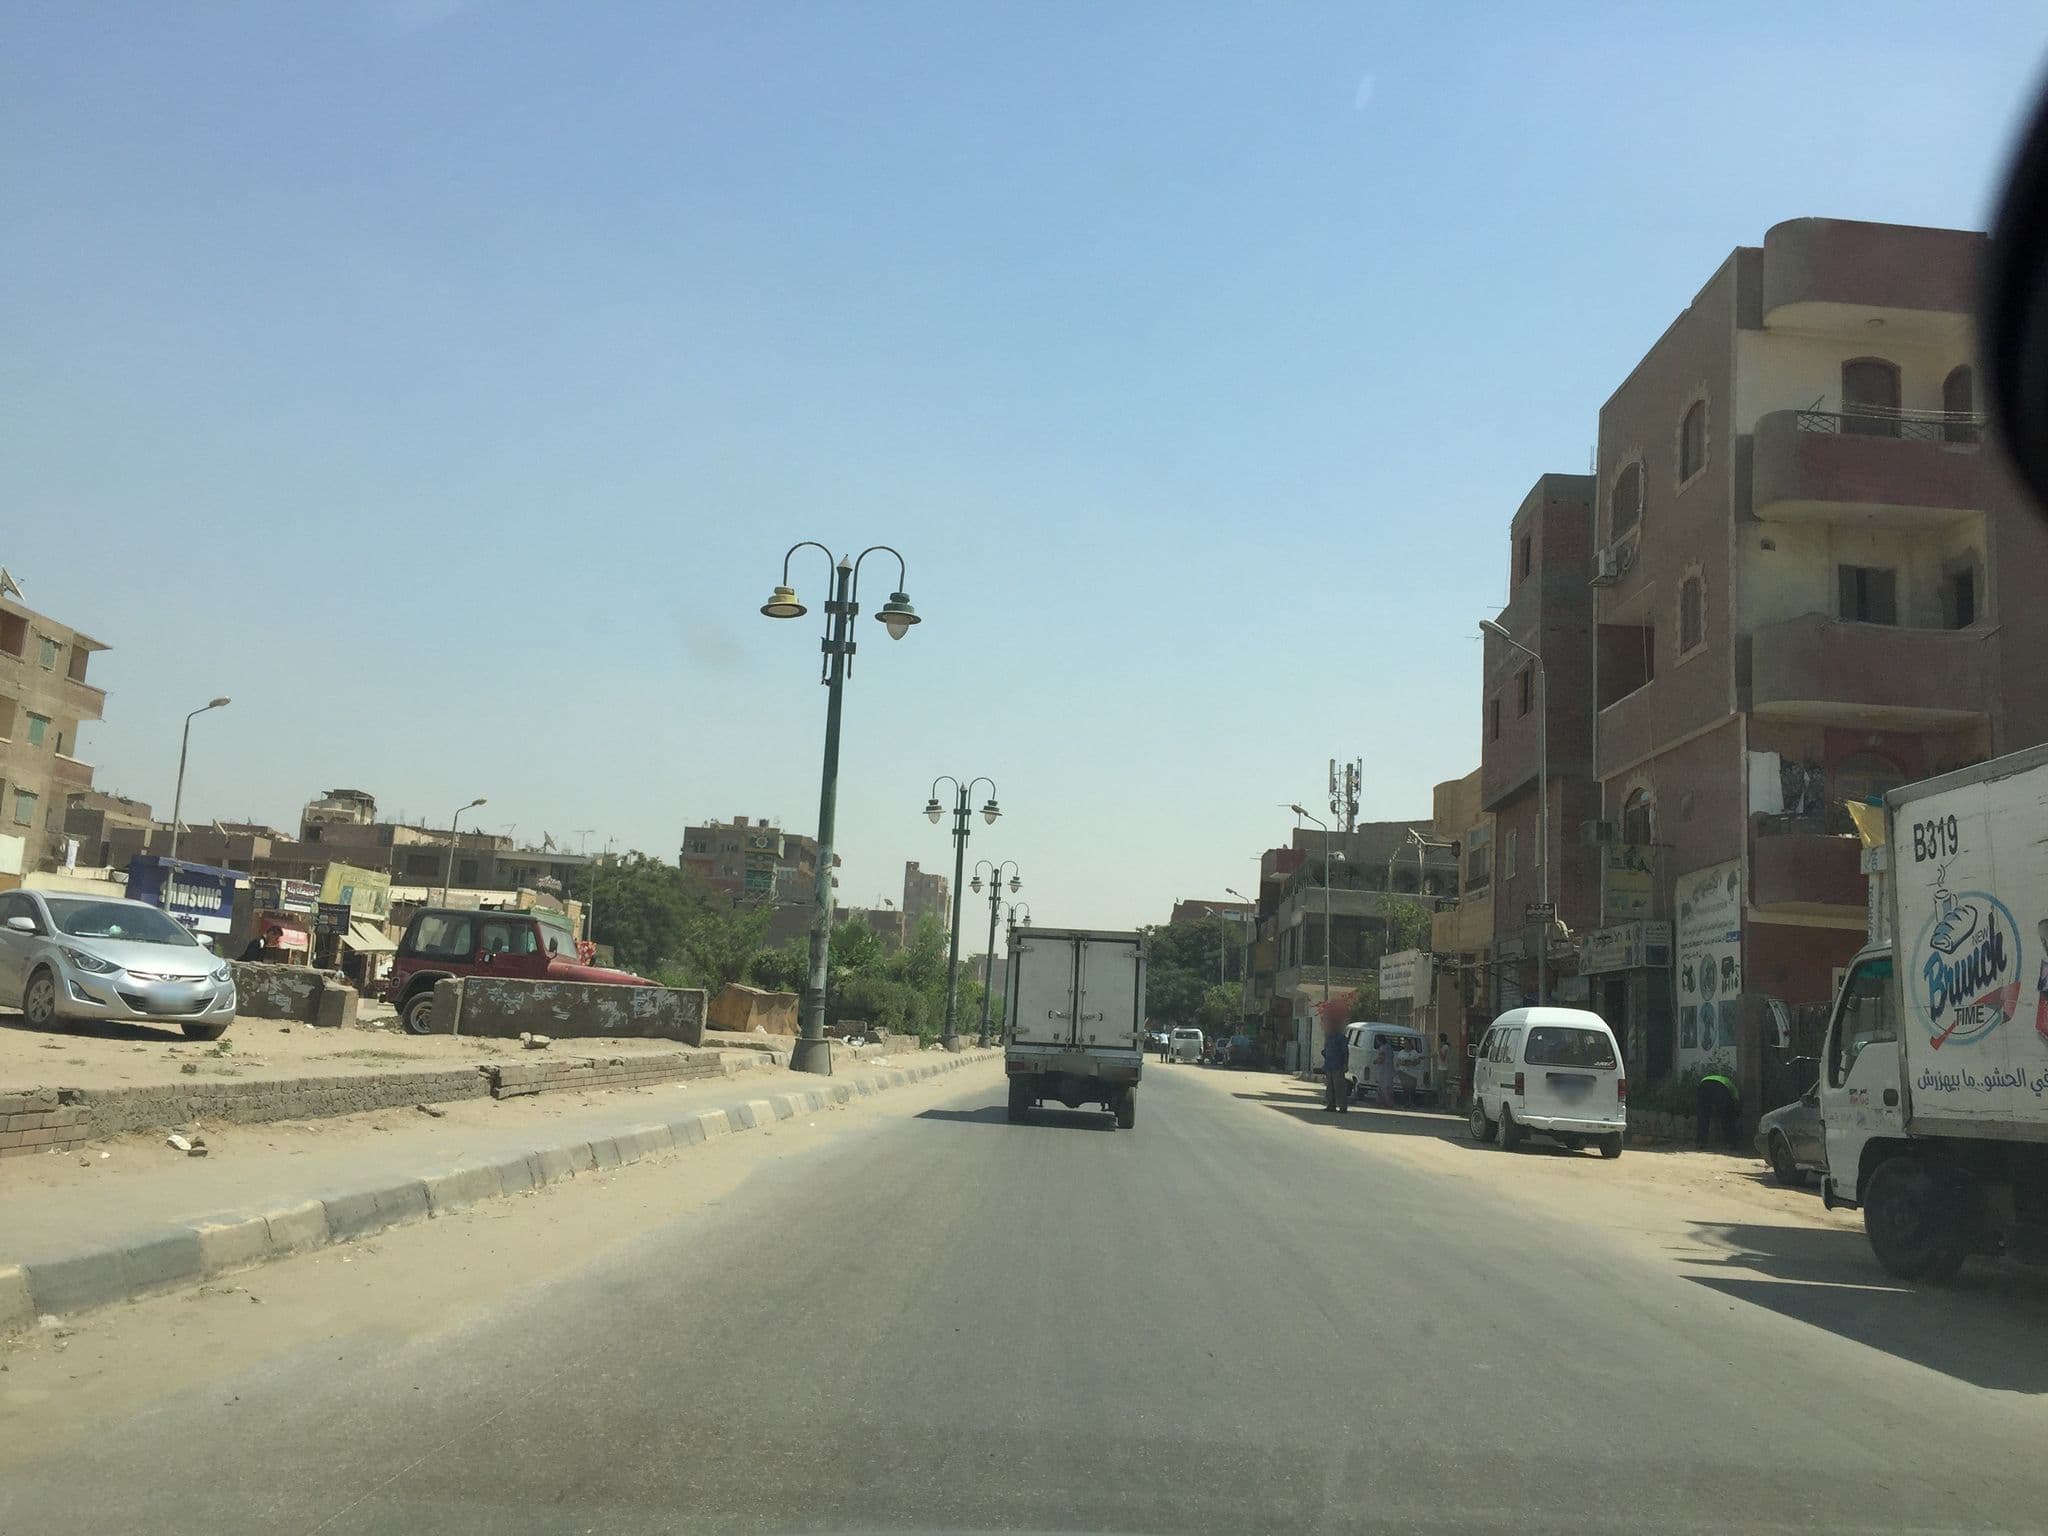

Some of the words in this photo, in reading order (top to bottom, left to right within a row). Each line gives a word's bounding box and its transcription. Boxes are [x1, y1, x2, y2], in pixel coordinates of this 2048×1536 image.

[1913, 814, 1958, 862] B319
[1971, 925, 1989, 946] NEW
[1923, 911, 2007, 1022] Brunch
[1954, 1005, 1985, 1026] TIME
[1917, 1067, 1960, 1092] بيهزرش
